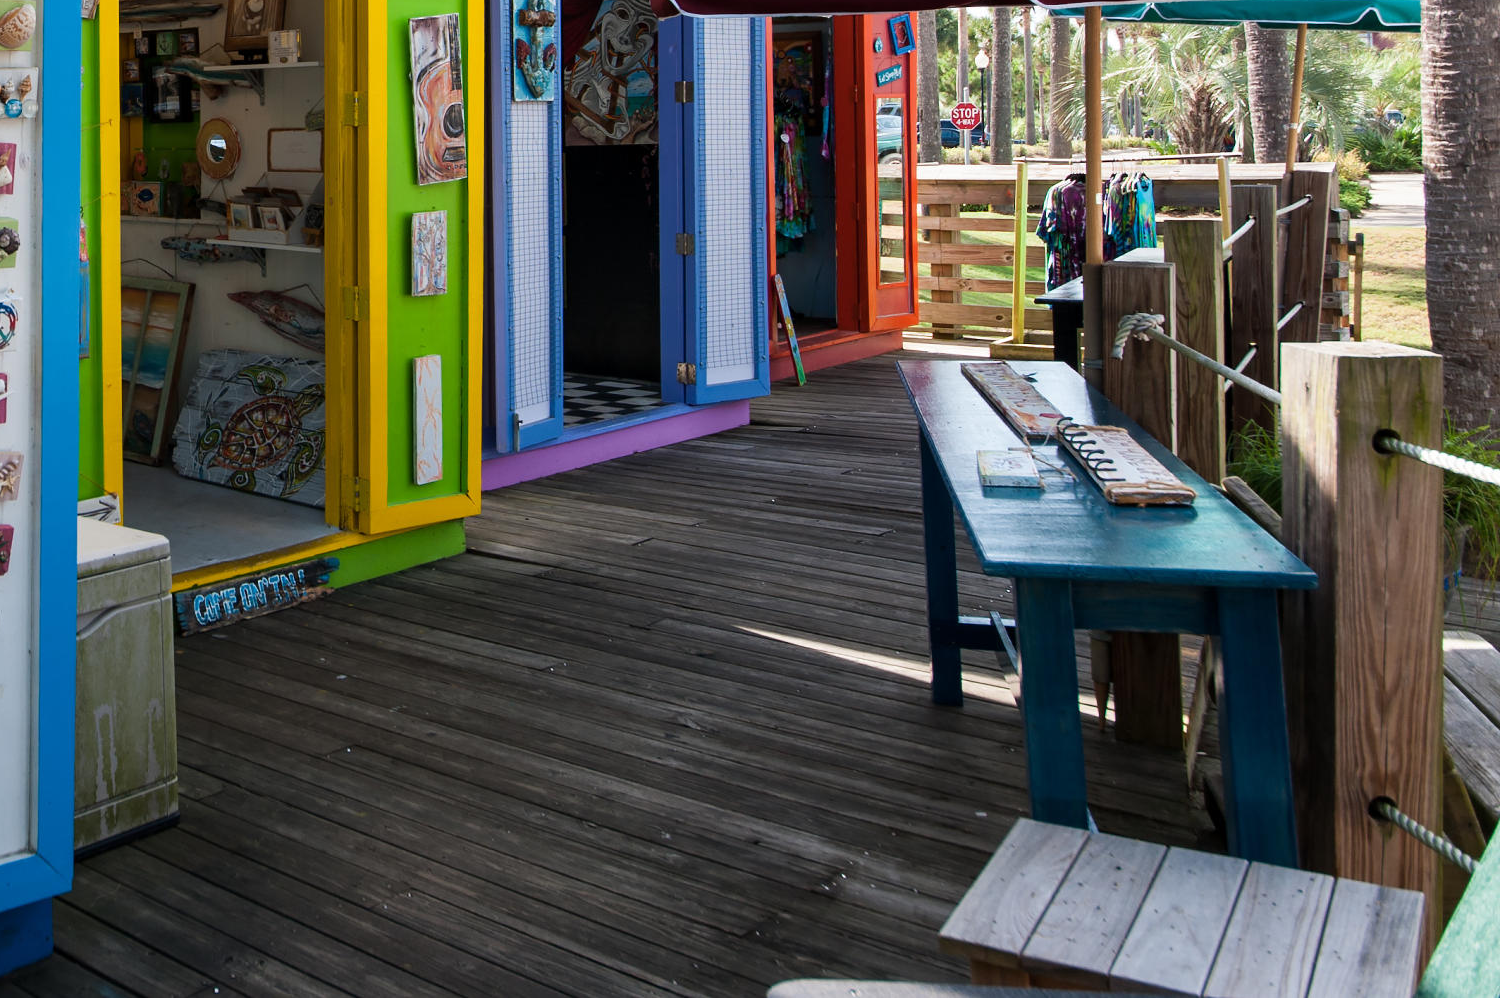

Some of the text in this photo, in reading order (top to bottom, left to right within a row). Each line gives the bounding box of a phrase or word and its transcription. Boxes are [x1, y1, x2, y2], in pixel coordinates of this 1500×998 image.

[953, 108, 978, 119] STOP
[193, 587, 240, 626] COME
[240, 579, 268, 612] ON
